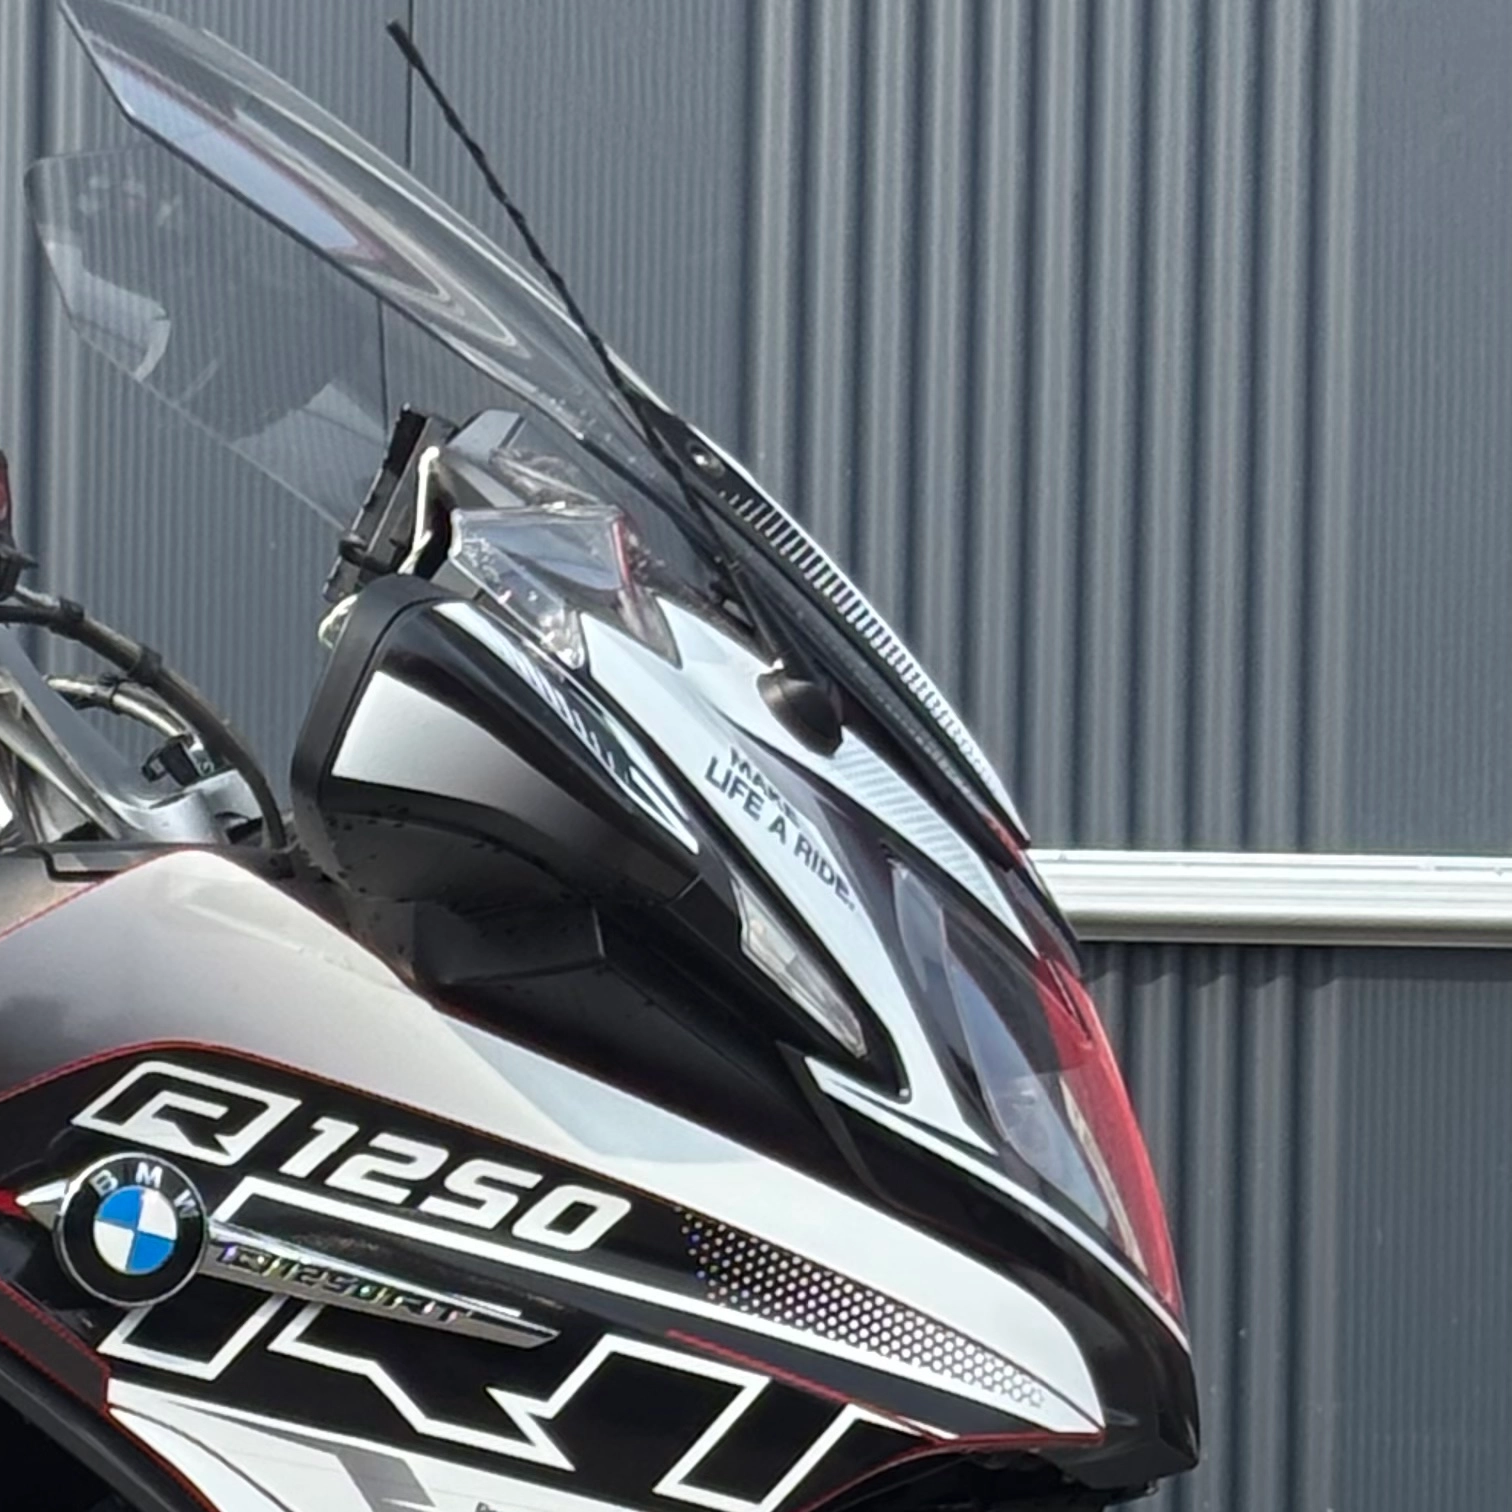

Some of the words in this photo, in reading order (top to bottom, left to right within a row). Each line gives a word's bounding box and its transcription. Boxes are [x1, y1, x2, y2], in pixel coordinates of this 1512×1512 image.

[704, 756, 765, 822] LIFE
[767, 814, 787, 846] A
[793, 833, 855, 911] RIDE.
[71, 1060, 302, 1167] R
[278, 1116, 632, 1253] 1250
[89, 1161, 200, 1219] BMW
